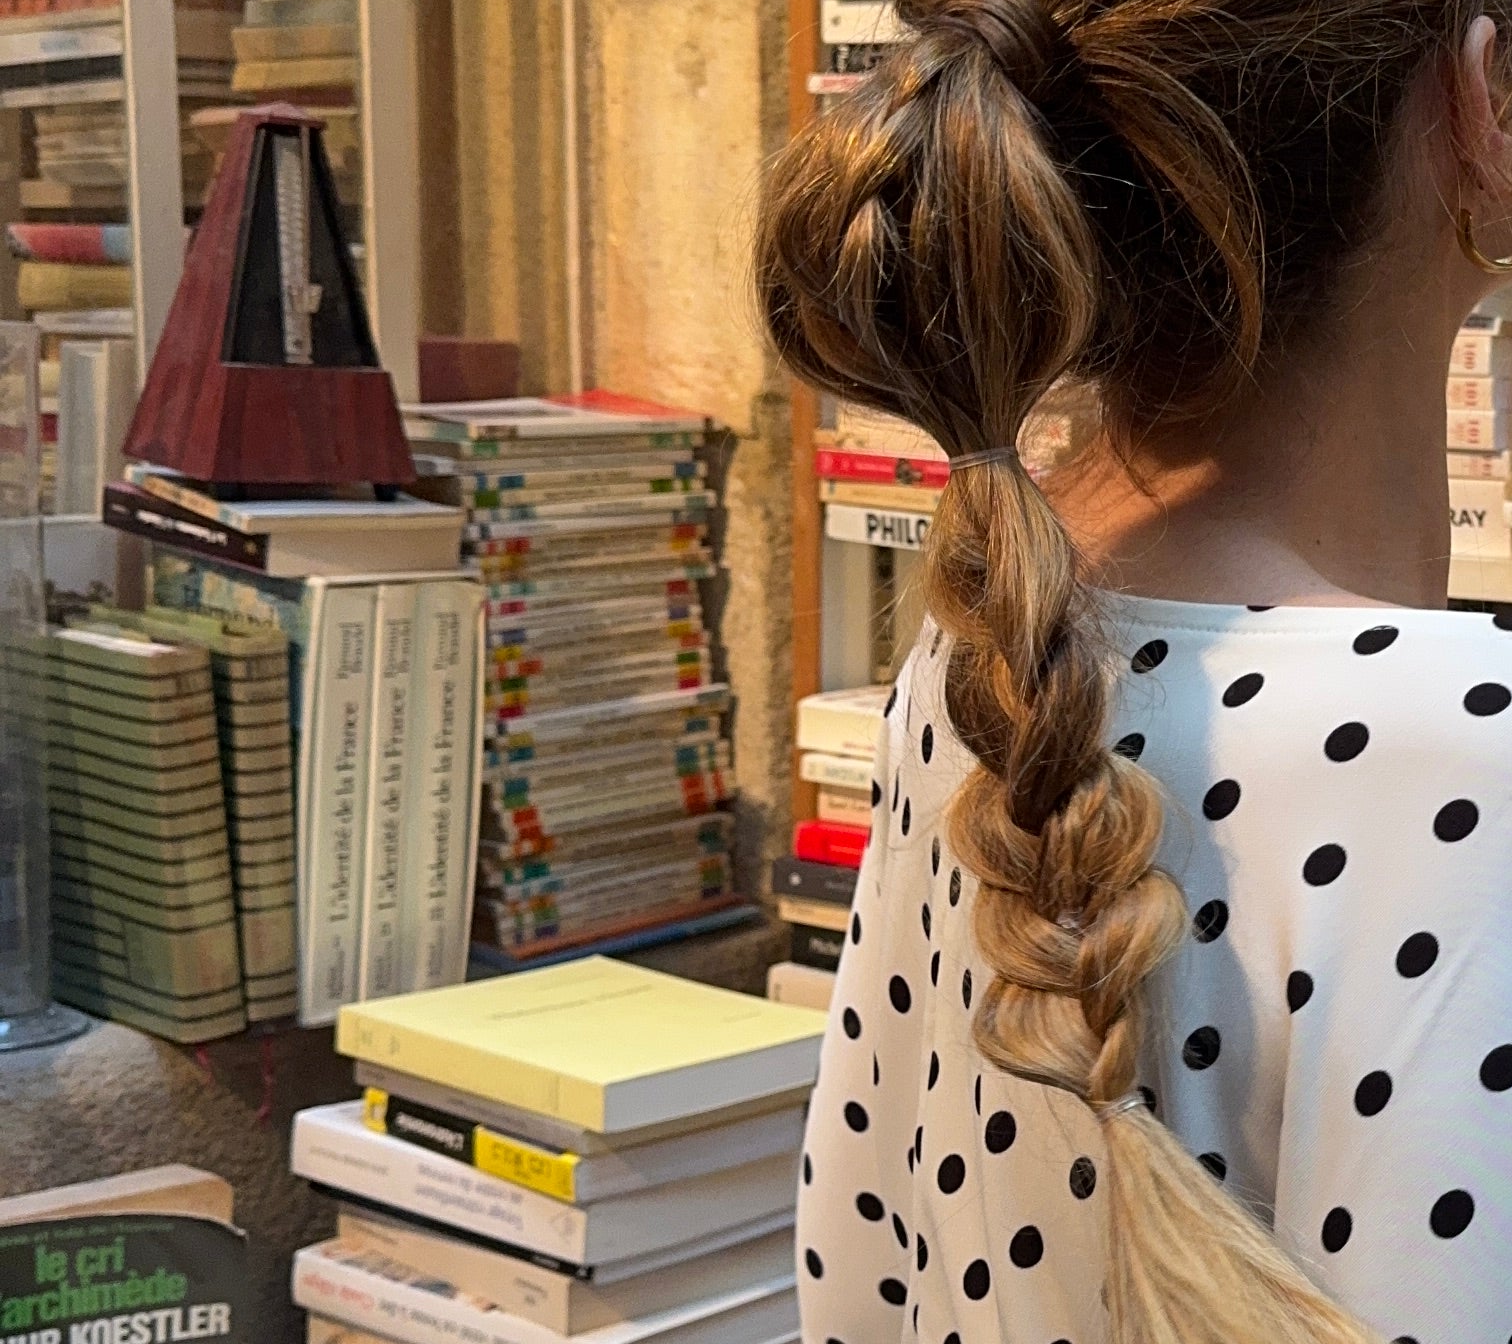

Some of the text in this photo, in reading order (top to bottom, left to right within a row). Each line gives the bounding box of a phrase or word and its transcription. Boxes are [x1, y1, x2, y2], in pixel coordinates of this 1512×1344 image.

[336, 701, 360, 773] France
[384, 686, 406, 759] France
[434, 679, 455, 751] France
[333, 798, 353, 826] de
[382, 787, 400, 813] de
[432, 779, 452, 805] de
[34, 1236, 125, 1284] le cri
